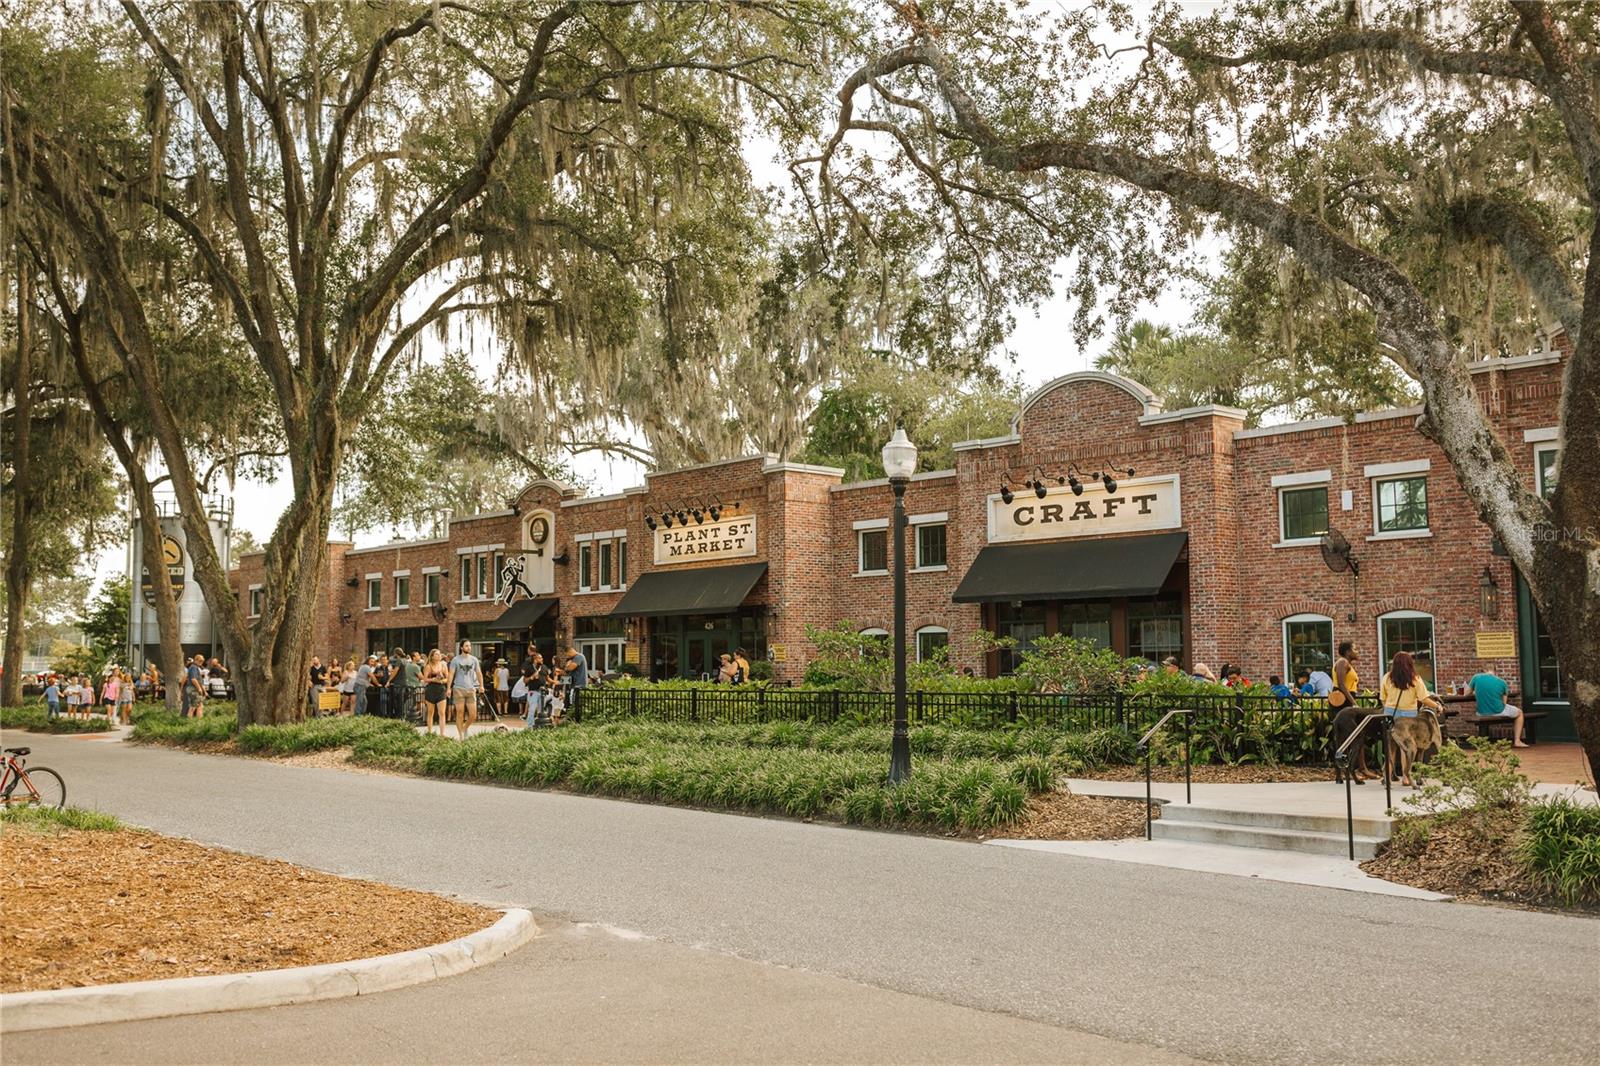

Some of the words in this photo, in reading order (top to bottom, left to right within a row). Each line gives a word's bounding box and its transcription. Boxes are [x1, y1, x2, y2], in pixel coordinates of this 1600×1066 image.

[1013, 494, 1157, 526] CRAFT
[662, 527, 721, 544] PLANT
[728, 523, 753, 536] ST.
[669, 538, 745, 556] MARKET
